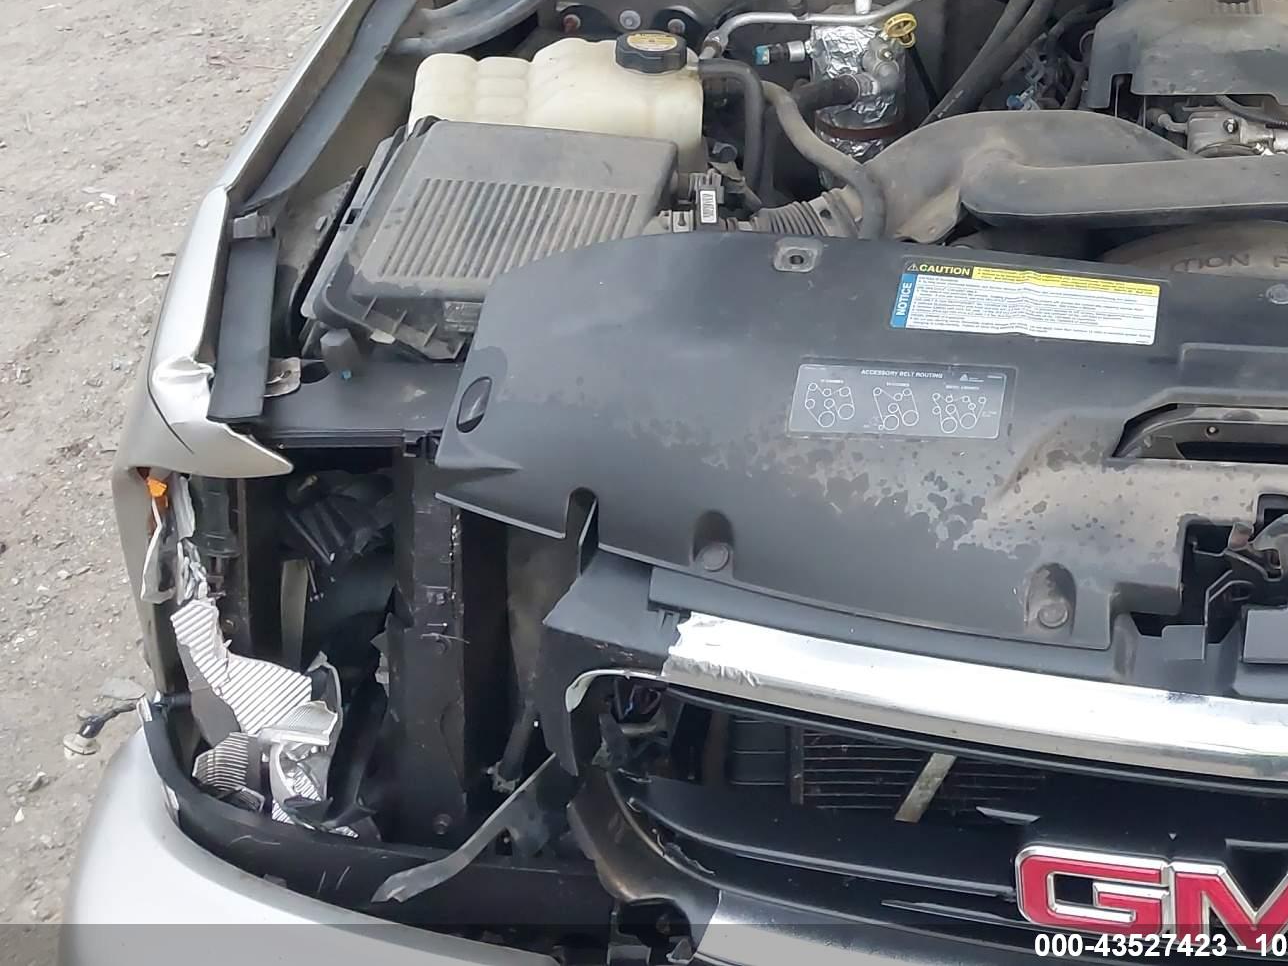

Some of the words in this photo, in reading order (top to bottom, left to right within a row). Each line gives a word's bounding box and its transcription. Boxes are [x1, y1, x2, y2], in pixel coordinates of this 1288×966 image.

[919, 264, 970, 275] CAUTION
[896, 282, 912, 315] NOTICE
[915, 371, 943, 379] ROUTING
